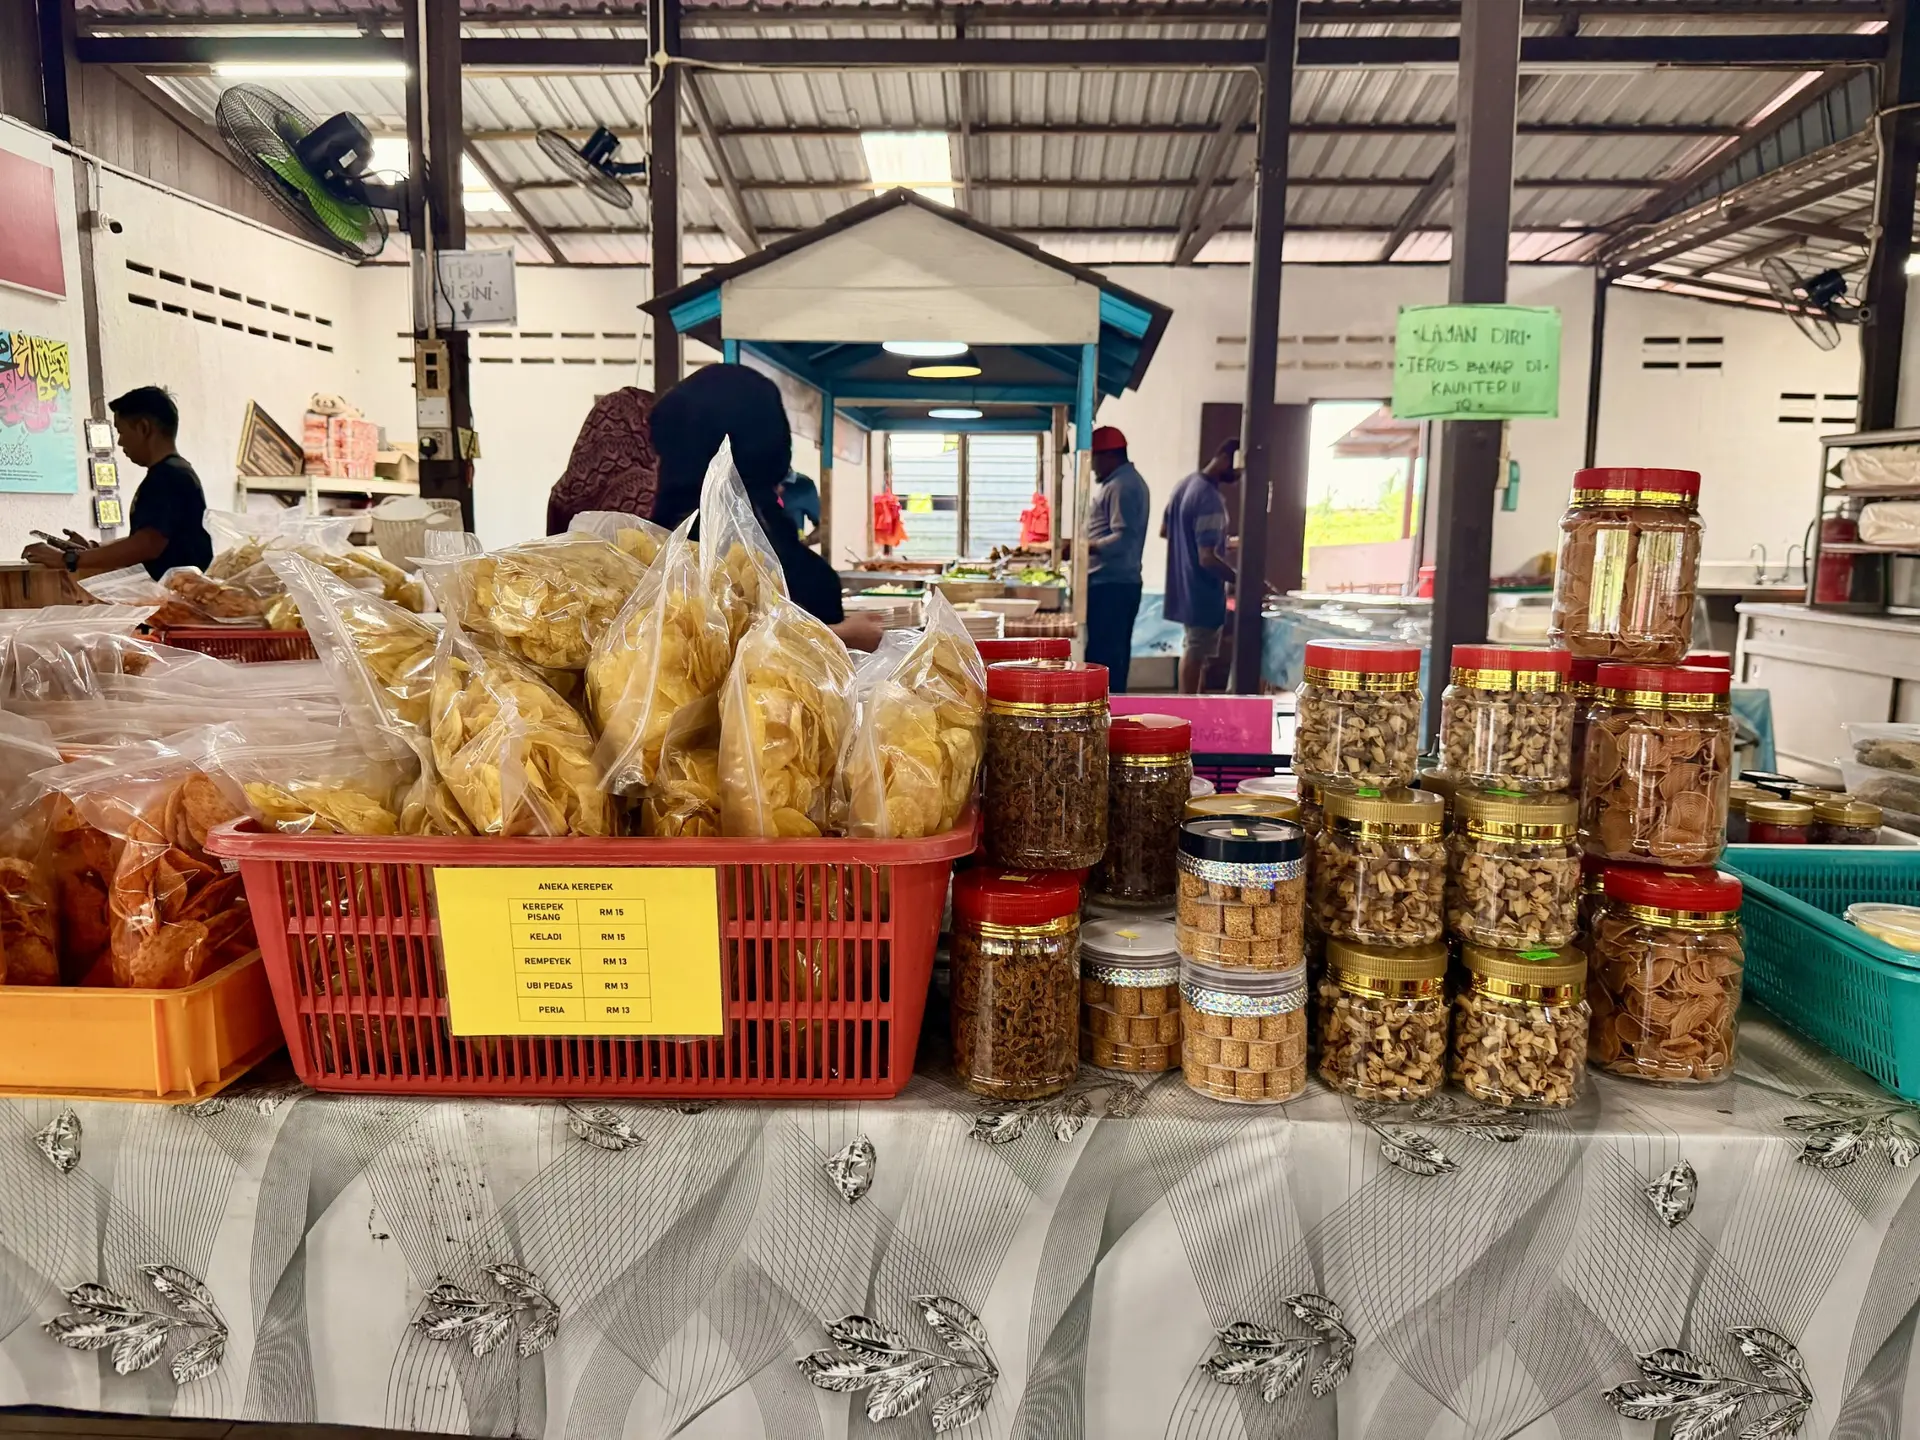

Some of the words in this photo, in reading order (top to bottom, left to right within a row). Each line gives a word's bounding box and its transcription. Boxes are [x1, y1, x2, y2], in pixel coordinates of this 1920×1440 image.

[1491, 327, 1525, 345] DIRI
[1406, 356, 1459, 373] TERUS
[538, 882, 570, 891] ANEKA
[571, 882, 614, 891] KEREPEK
[522, 902, 564, 911] KEREPEK
[599, 908, 613, 916] RM
[615, 908, 624, 916] 15
[527, 913, 561, 921] PISANG
[529, 932, 562, 941] KELADI
[601, 933, 615, 941] RM
[617, 933, 626, 941] 15
[524, 957, 572, 965] REMPEYEK
[602, 957, 617, 966] RM
[618, 957, 628, 966] 13
[526, 981, 542, 990] UBI
[543, 981, 573, 990] PEDAS
[604, 982, 618, 990] RM
[620, 982, 629, 990] 13
[538, 1005, 565, 1014] PERIA
[606, 1006, 620, 1014] RM
[621, 1006, 630, 1014] 13
